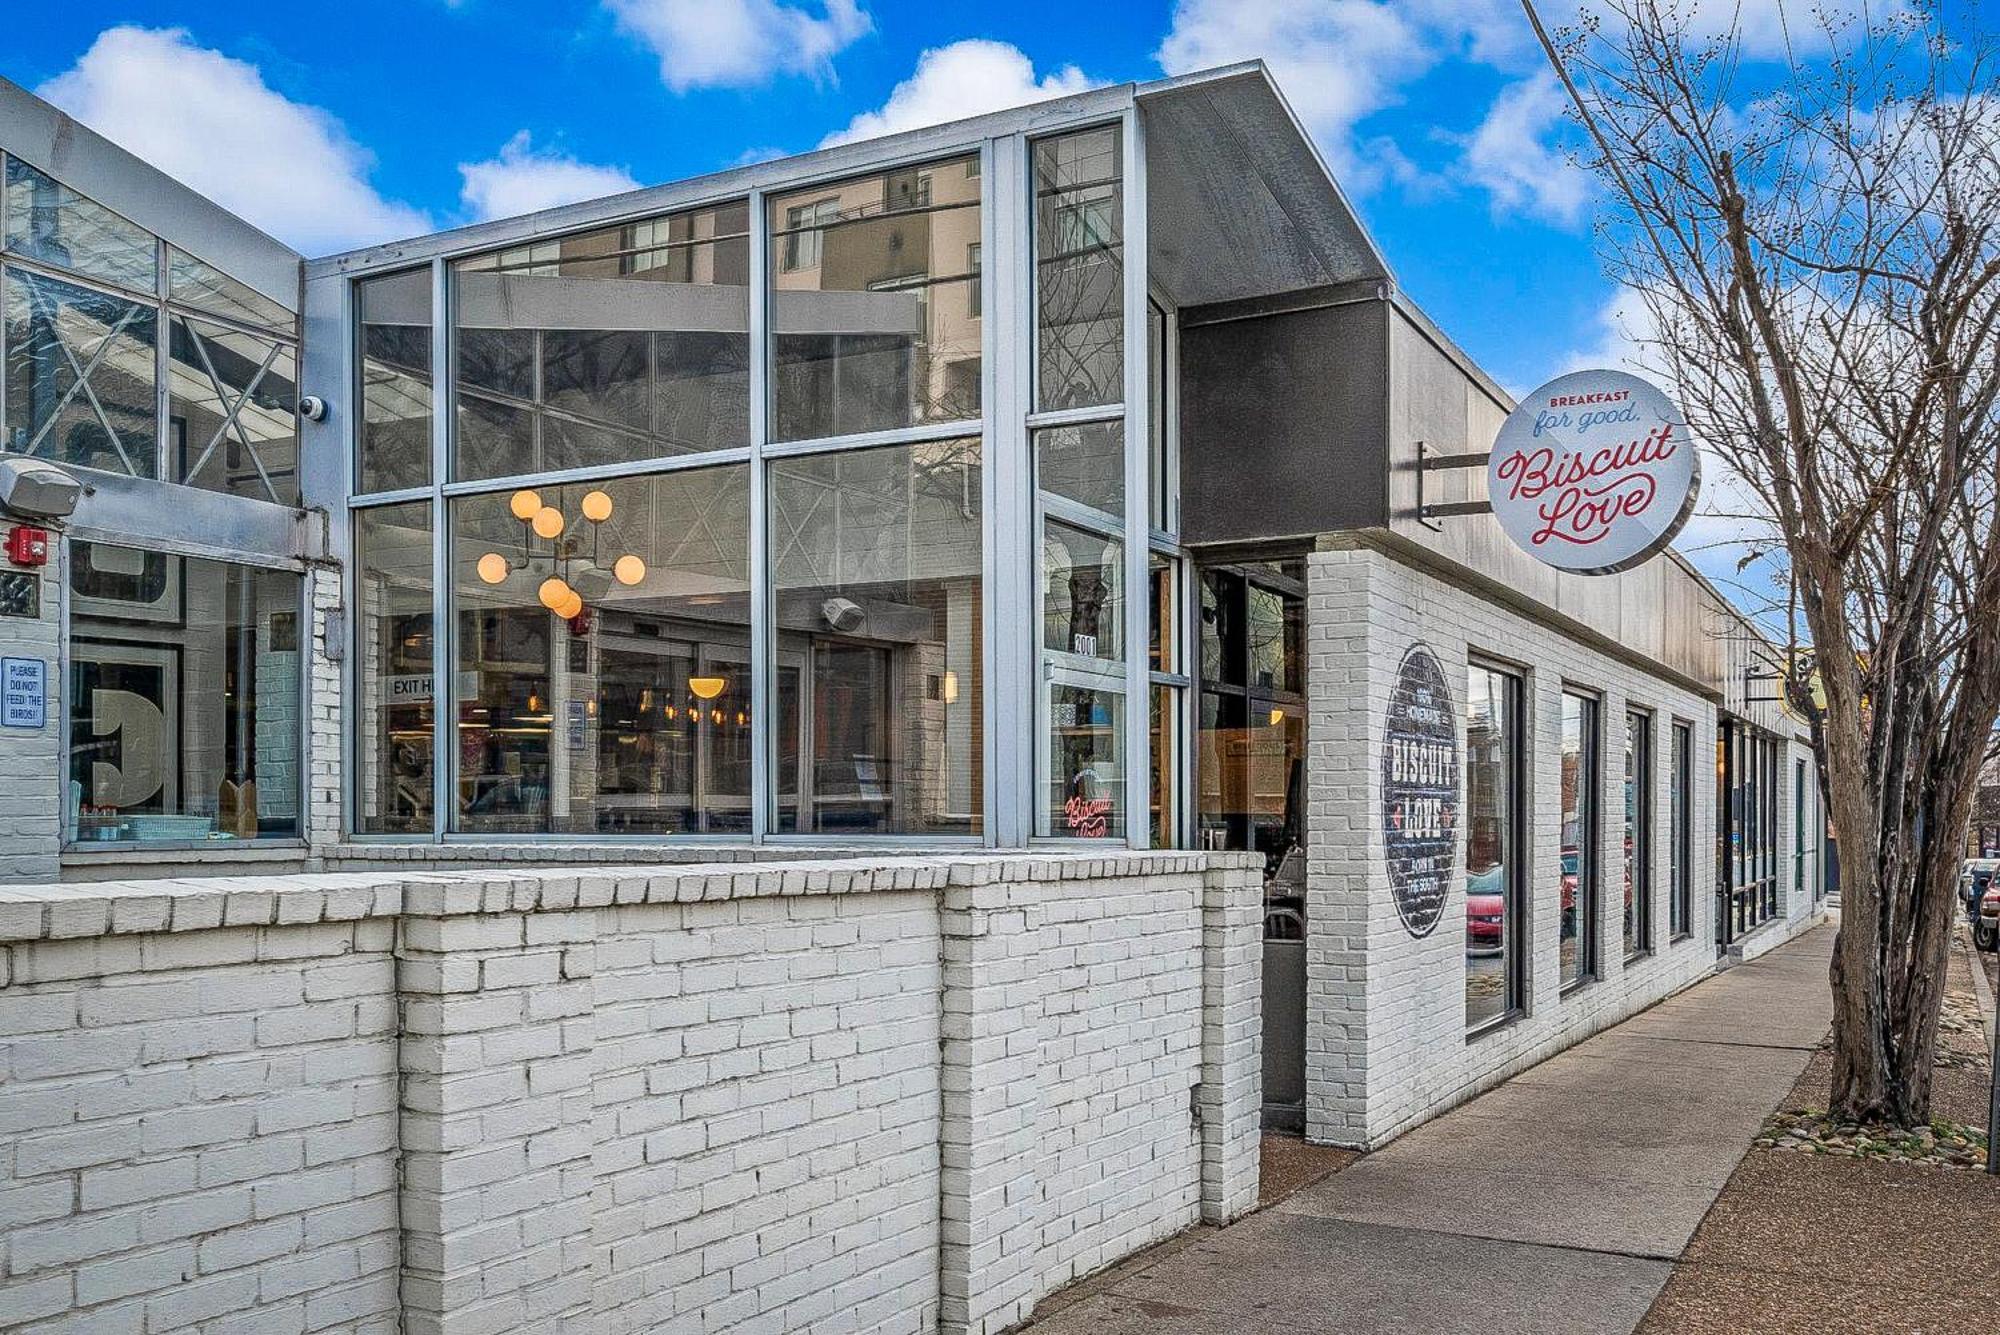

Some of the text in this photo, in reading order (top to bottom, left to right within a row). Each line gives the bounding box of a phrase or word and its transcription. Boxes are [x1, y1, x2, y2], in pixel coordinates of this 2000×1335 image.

[1550, 390, 1630, 408] BREAKFAST
[1532, 401, 1640, 438] for good.
[1497, 423, 1677, 500] Biscuit
[1531, 473, 1656, 544] Love
[1075, 635, 1096, 656] 2001
[10, 665, 39, 677] PLEASE
[10, 680, 37, 691] DO NOT
[394, 679, 419, 694] EXIT
[6, 693, 42, 706] FEED THE
[1391, 739, 1453, 785] BISCUIT
[1404, 798, 1441, 838] LOVE
